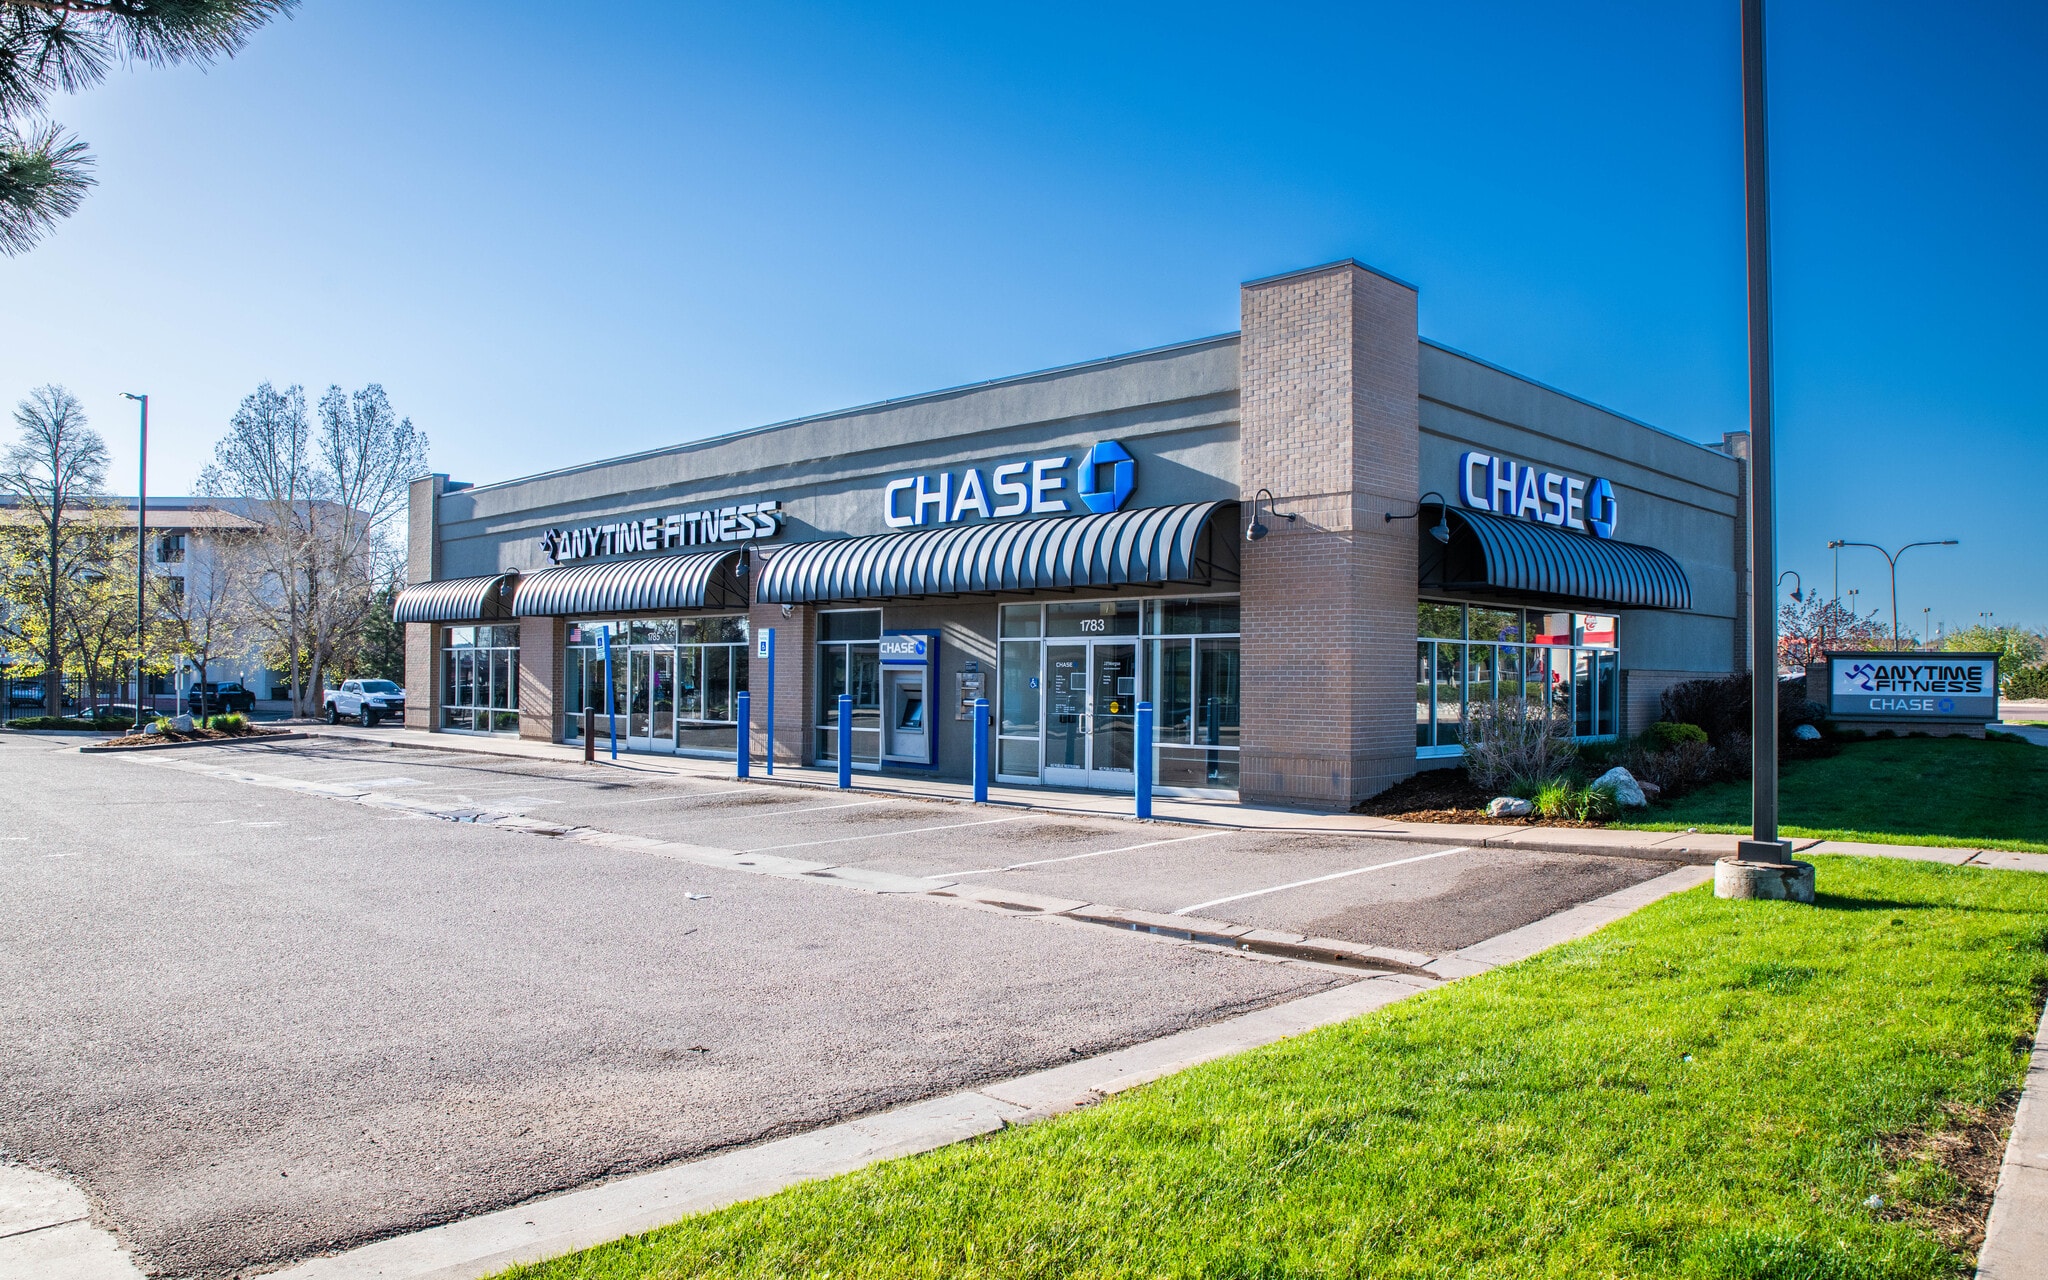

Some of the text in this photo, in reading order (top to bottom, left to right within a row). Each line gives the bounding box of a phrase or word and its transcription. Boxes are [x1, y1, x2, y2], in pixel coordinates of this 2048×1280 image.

[885, 456, 1072, 528] CHASE
[1460, 451, 1585, 531] CHASE
[557, 500, 780, 561] ANYTIME FITNESS
[1080, 619, 1105, 632] 1783
[880, 642, 915, 654] CHASE
[1874, 665, 1982, 681] ANYTIME
[1876, 680, 1982, 693] FITNESS
[1869, 698, 1934, 711] CHASE
